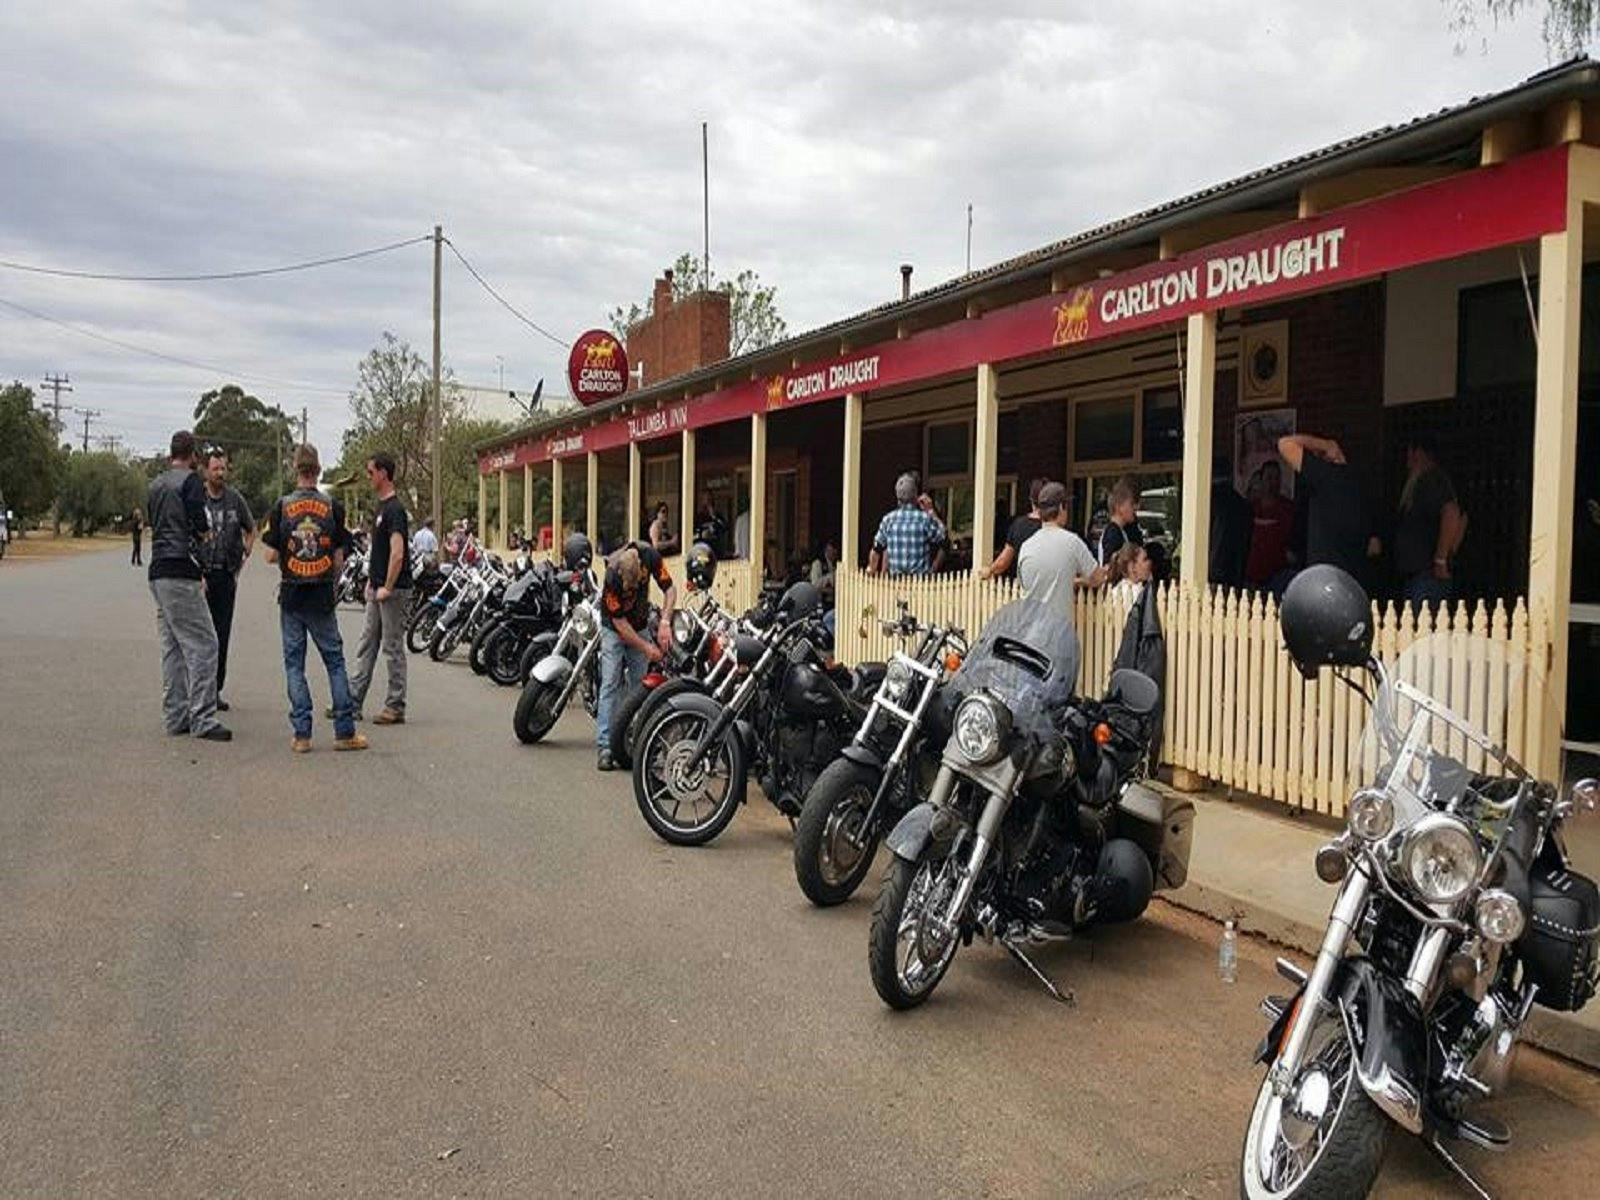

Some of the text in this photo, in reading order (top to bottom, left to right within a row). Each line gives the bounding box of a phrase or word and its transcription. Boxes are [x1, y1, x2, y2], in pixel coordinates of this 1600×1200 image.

[1100, 227, 1345, 323] CARLTON DRAUGHT
[578, 379, 623, 393] DRAUGHT
[581, 368, 621, 381] CARLTON
[786, 356, 879, 400] CARLTON DRAUGHT
